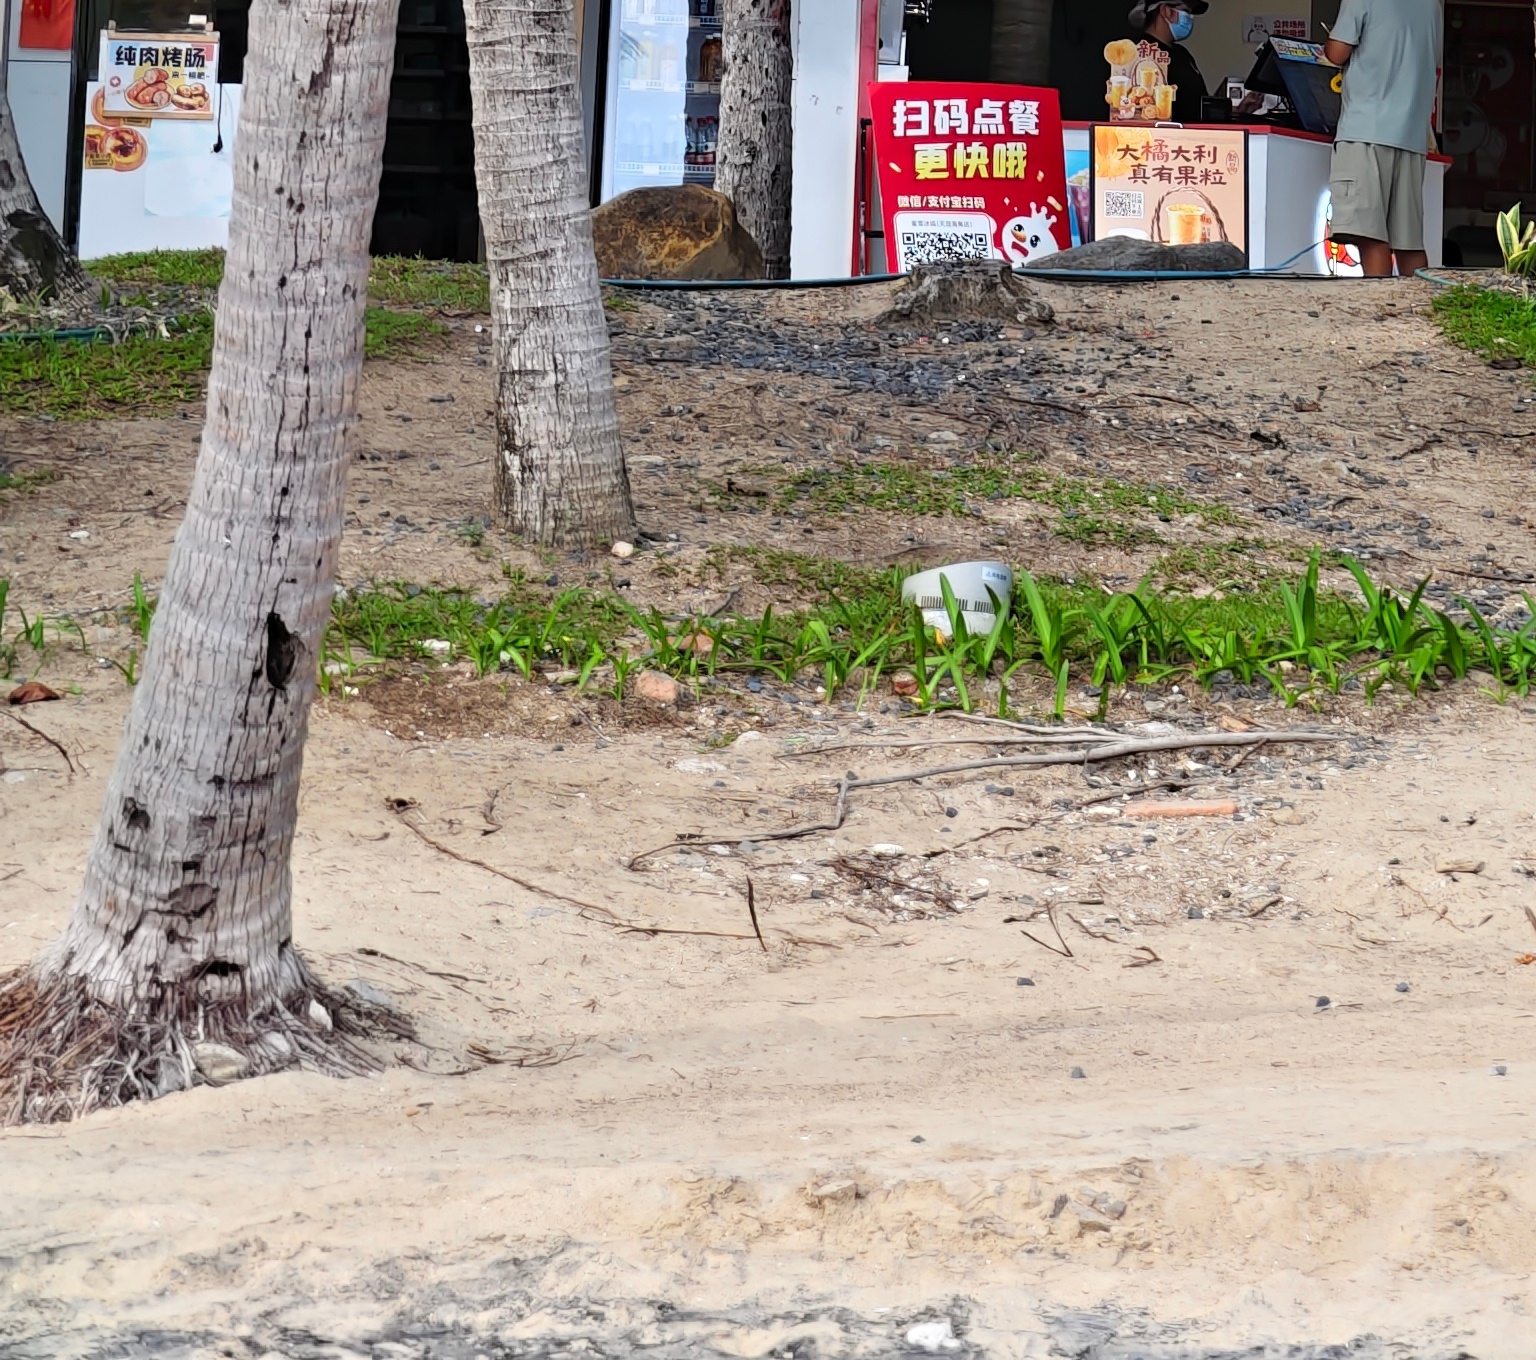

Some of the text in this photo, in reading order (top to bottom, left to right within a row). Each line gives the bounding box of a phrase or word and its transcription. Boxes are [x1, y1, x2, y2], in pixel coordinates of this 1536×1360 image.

[115, 45, 206, 68] 纯肉烤肠
[1136, 41, 1171, 64] 新品
[892, 98, 1041, 137] 扫码点餐
[913, 141, 1028, 180] 更快哦
[1116, 138, 1218, 164] 大橘大利
[1127, 164, 1227, 187] 真有果粒
[897, 195, 986, 210] 微信/支付宝扫码
